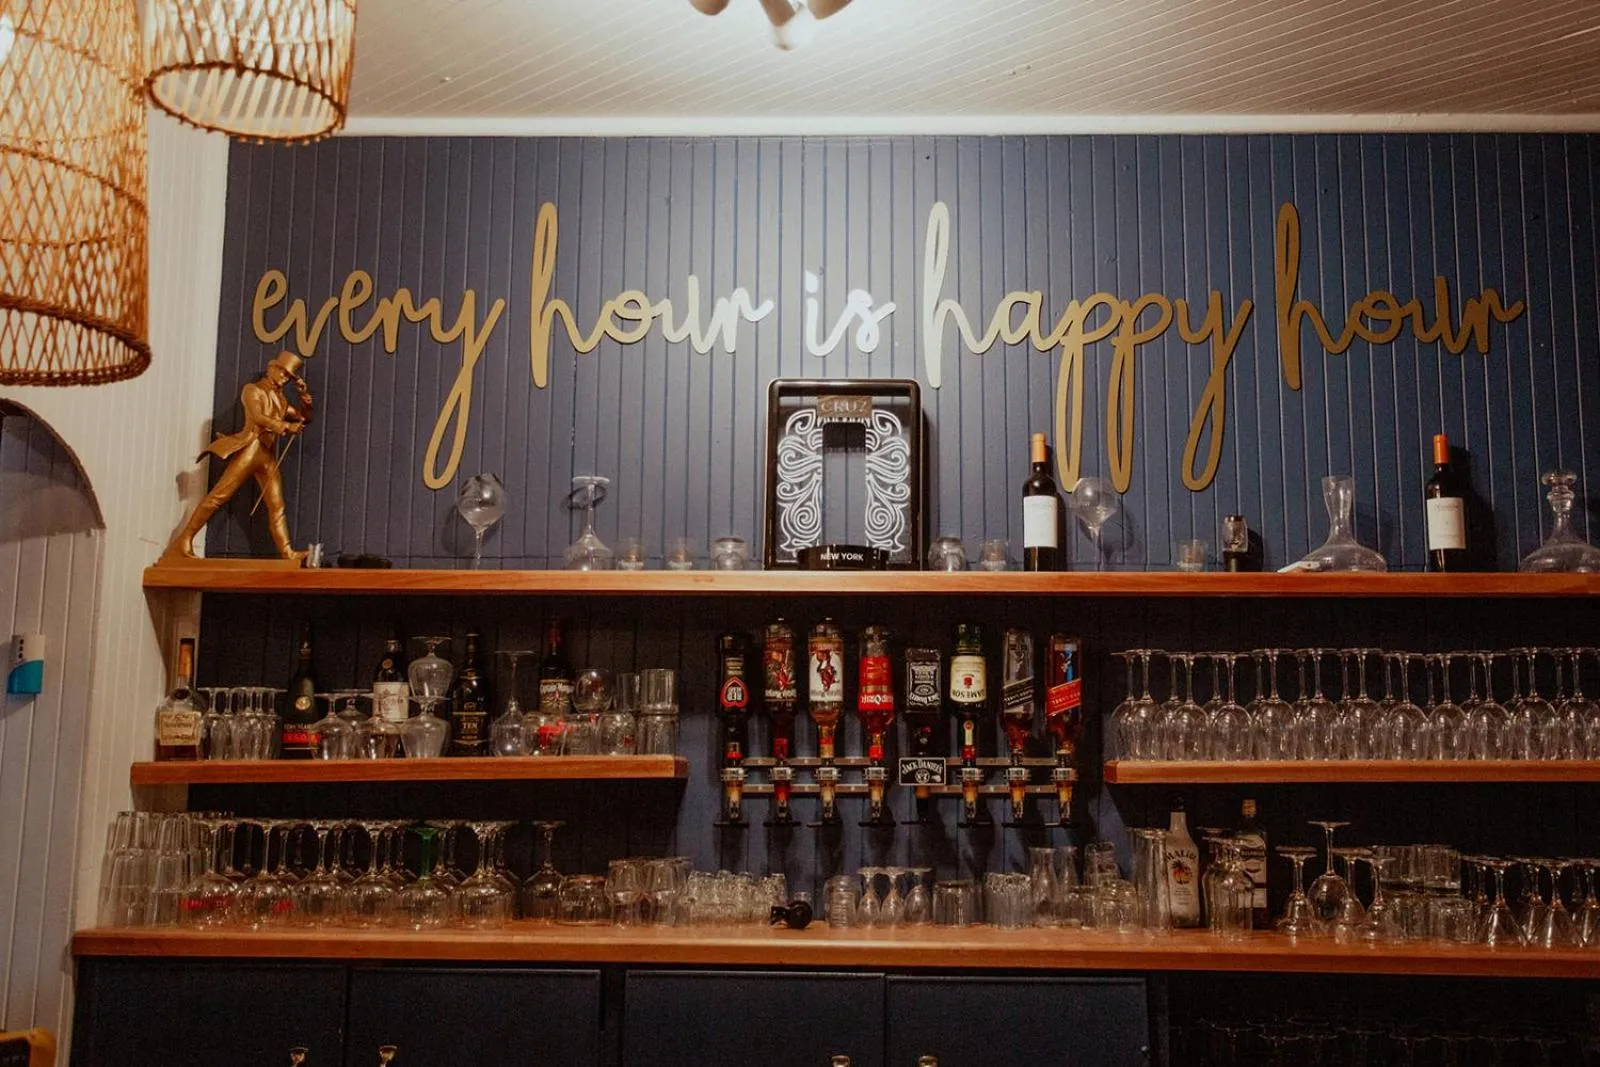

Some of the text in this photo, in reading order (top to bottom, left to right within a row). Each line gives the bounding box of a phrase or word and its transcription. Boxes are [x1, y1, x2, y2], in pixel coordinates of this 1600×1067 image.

[252, 201, 1524, 494] every hour is happy hour
[820, 399, 868, 413] CRUZ
[820, 553, 864, 562] NEW YORK
[951, 688, 986, 699] JAMESON
[901, 761, 918, 775] JACK
